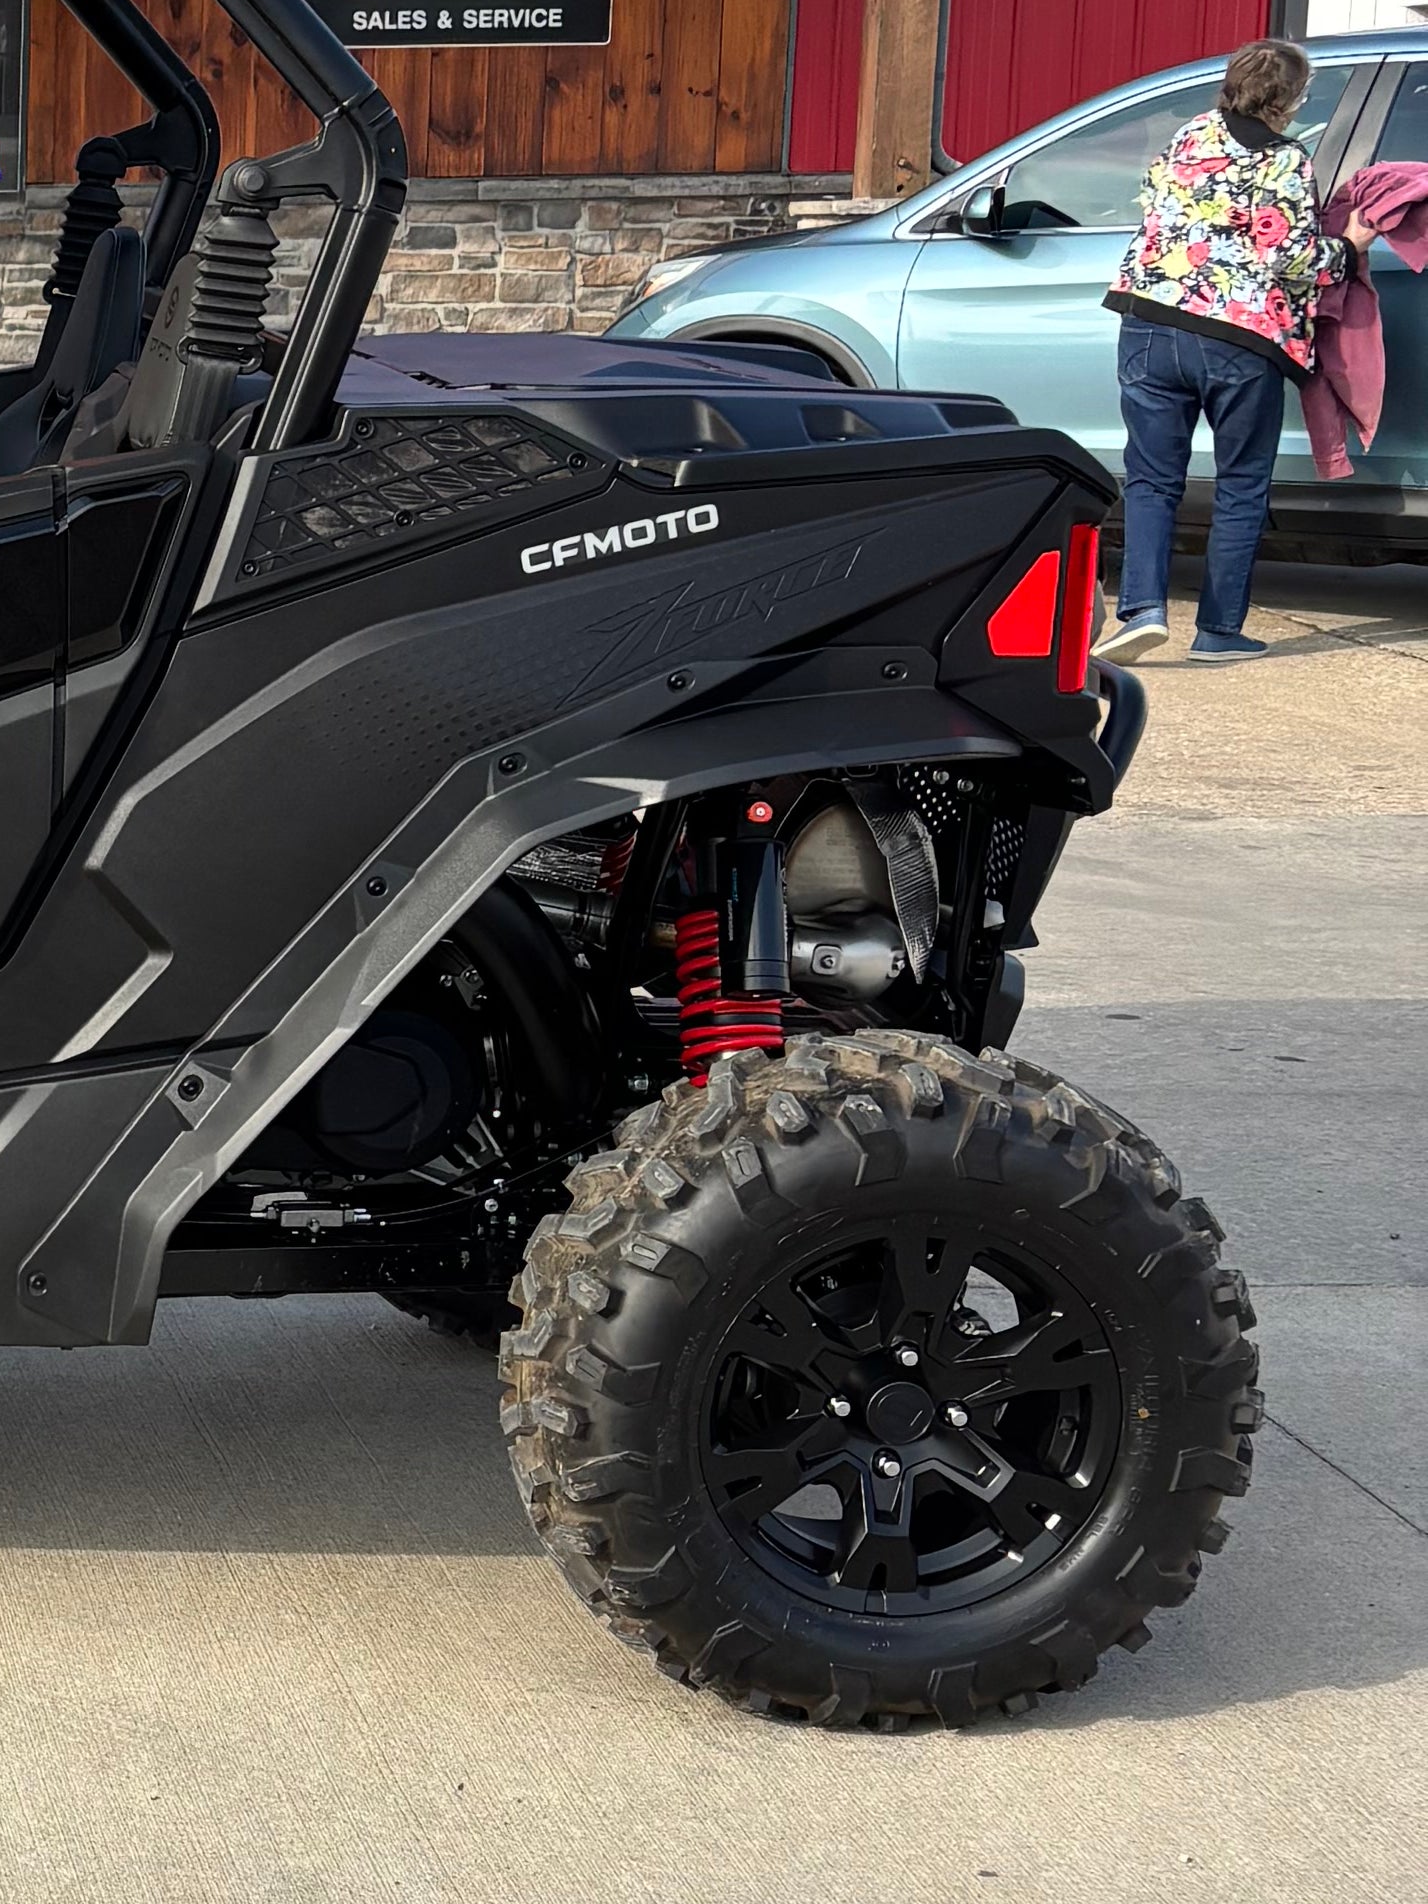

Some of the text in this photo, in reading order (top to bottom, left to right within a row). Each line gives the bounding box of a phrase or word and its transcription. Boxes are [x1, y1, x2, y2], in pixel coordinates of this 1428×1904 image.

[352, 8, 564, 31] SALES & SERVICE
[519, 503, 720, 575] CFMOTO
